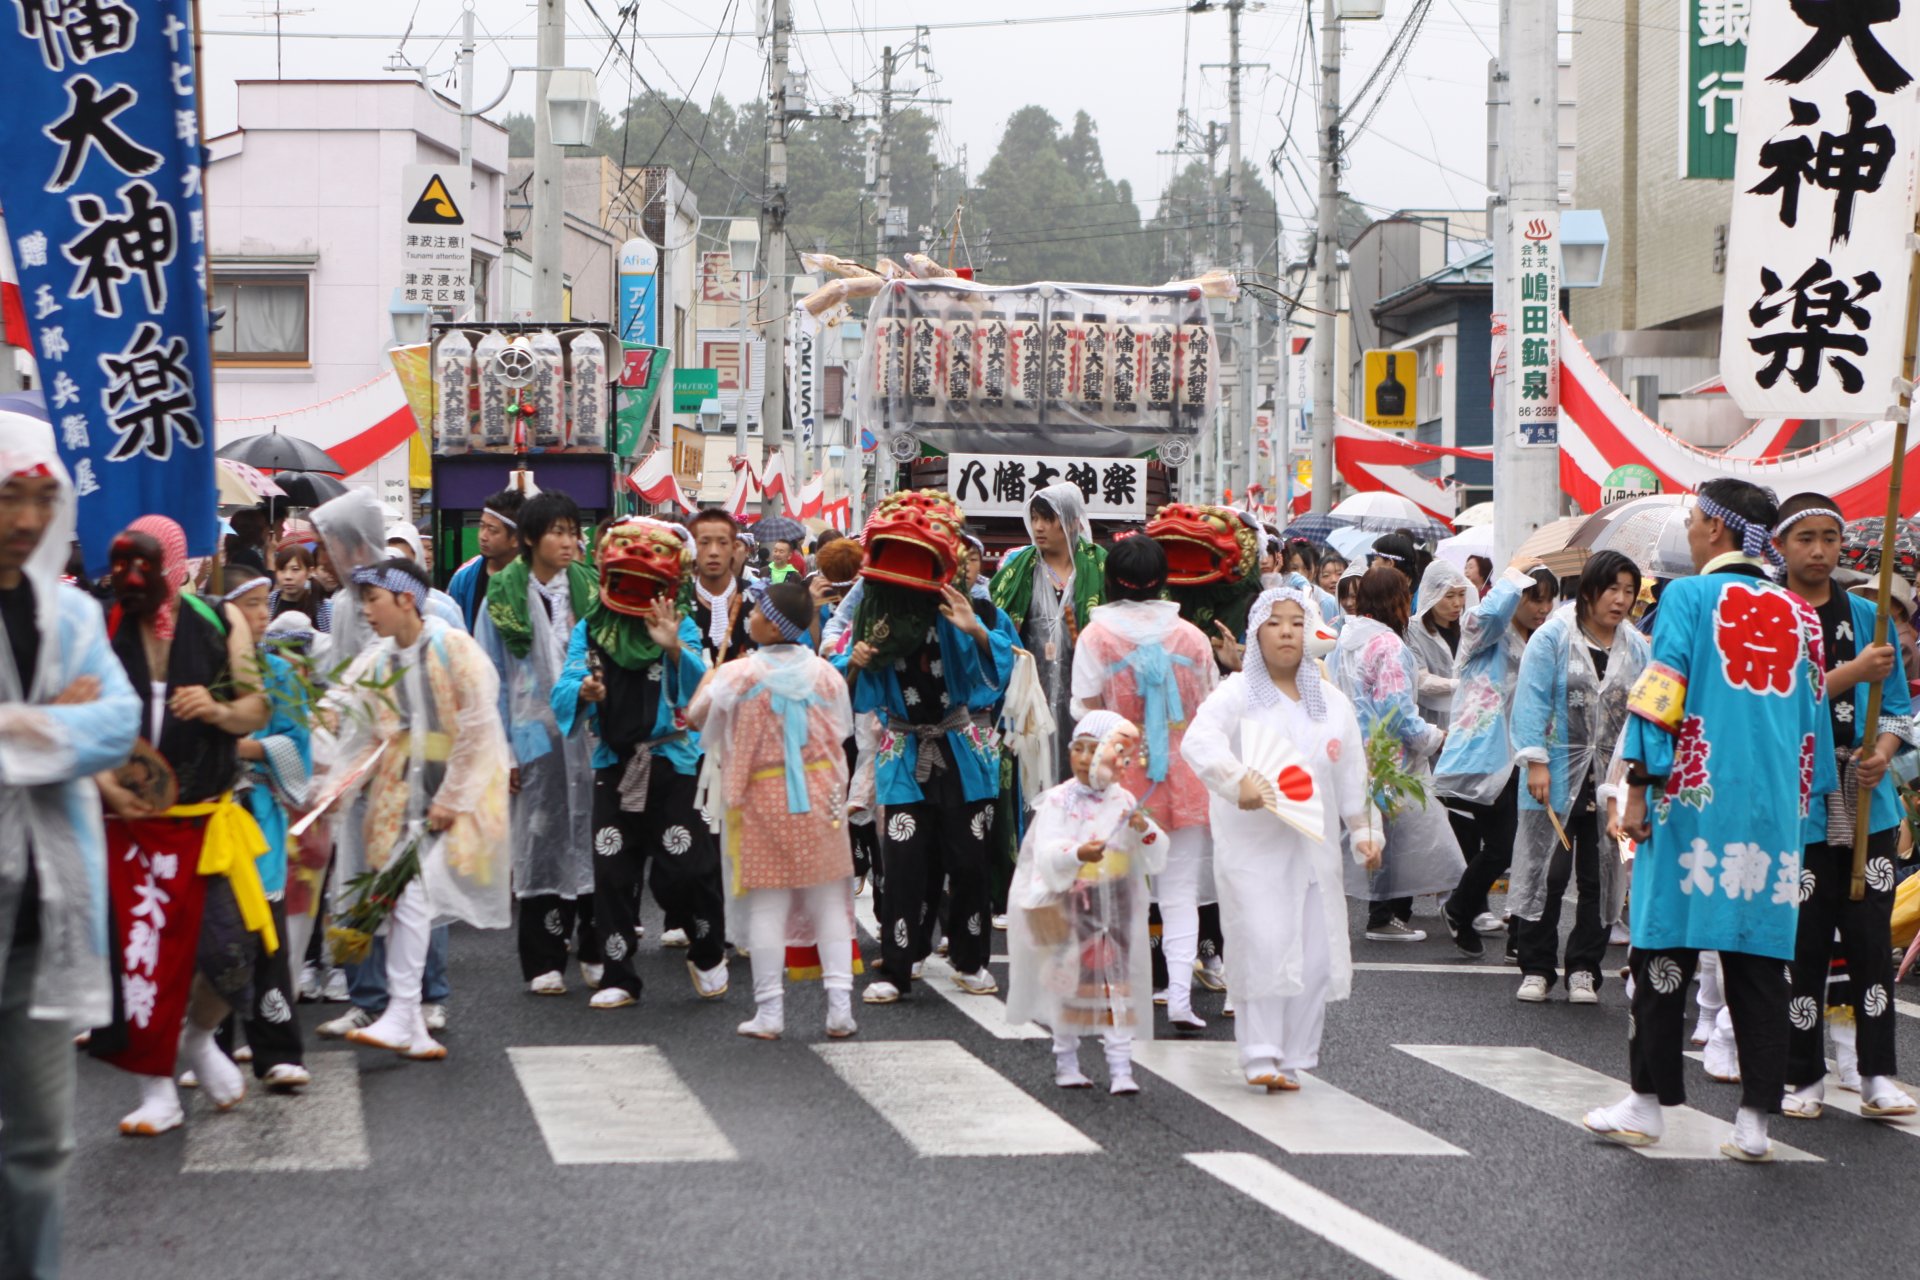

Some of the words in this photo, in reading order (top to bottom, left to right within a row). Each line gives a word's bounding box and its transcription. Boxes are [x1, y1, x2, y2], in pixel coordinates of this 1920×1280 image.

[406, 235, 465, 249] 津波注意!
[406, 251, 434, 260] Tsunami
[435, 252, 465, 261] attention
[405, 273, 466, 287] 津波浸水
[405, 289, 466, 302] 想定区域
[1521, 272, 1549, 401] 嶋田鉱泉
[795, 331, 813, 419] OKUYO
[672, 381, 714, 391] SHISEIDO
[1518, 406, 1558, 417] 86-2355
[1524, 426, 1556, 439] 中央町
[1713, 582, 1800, 697] 祭
